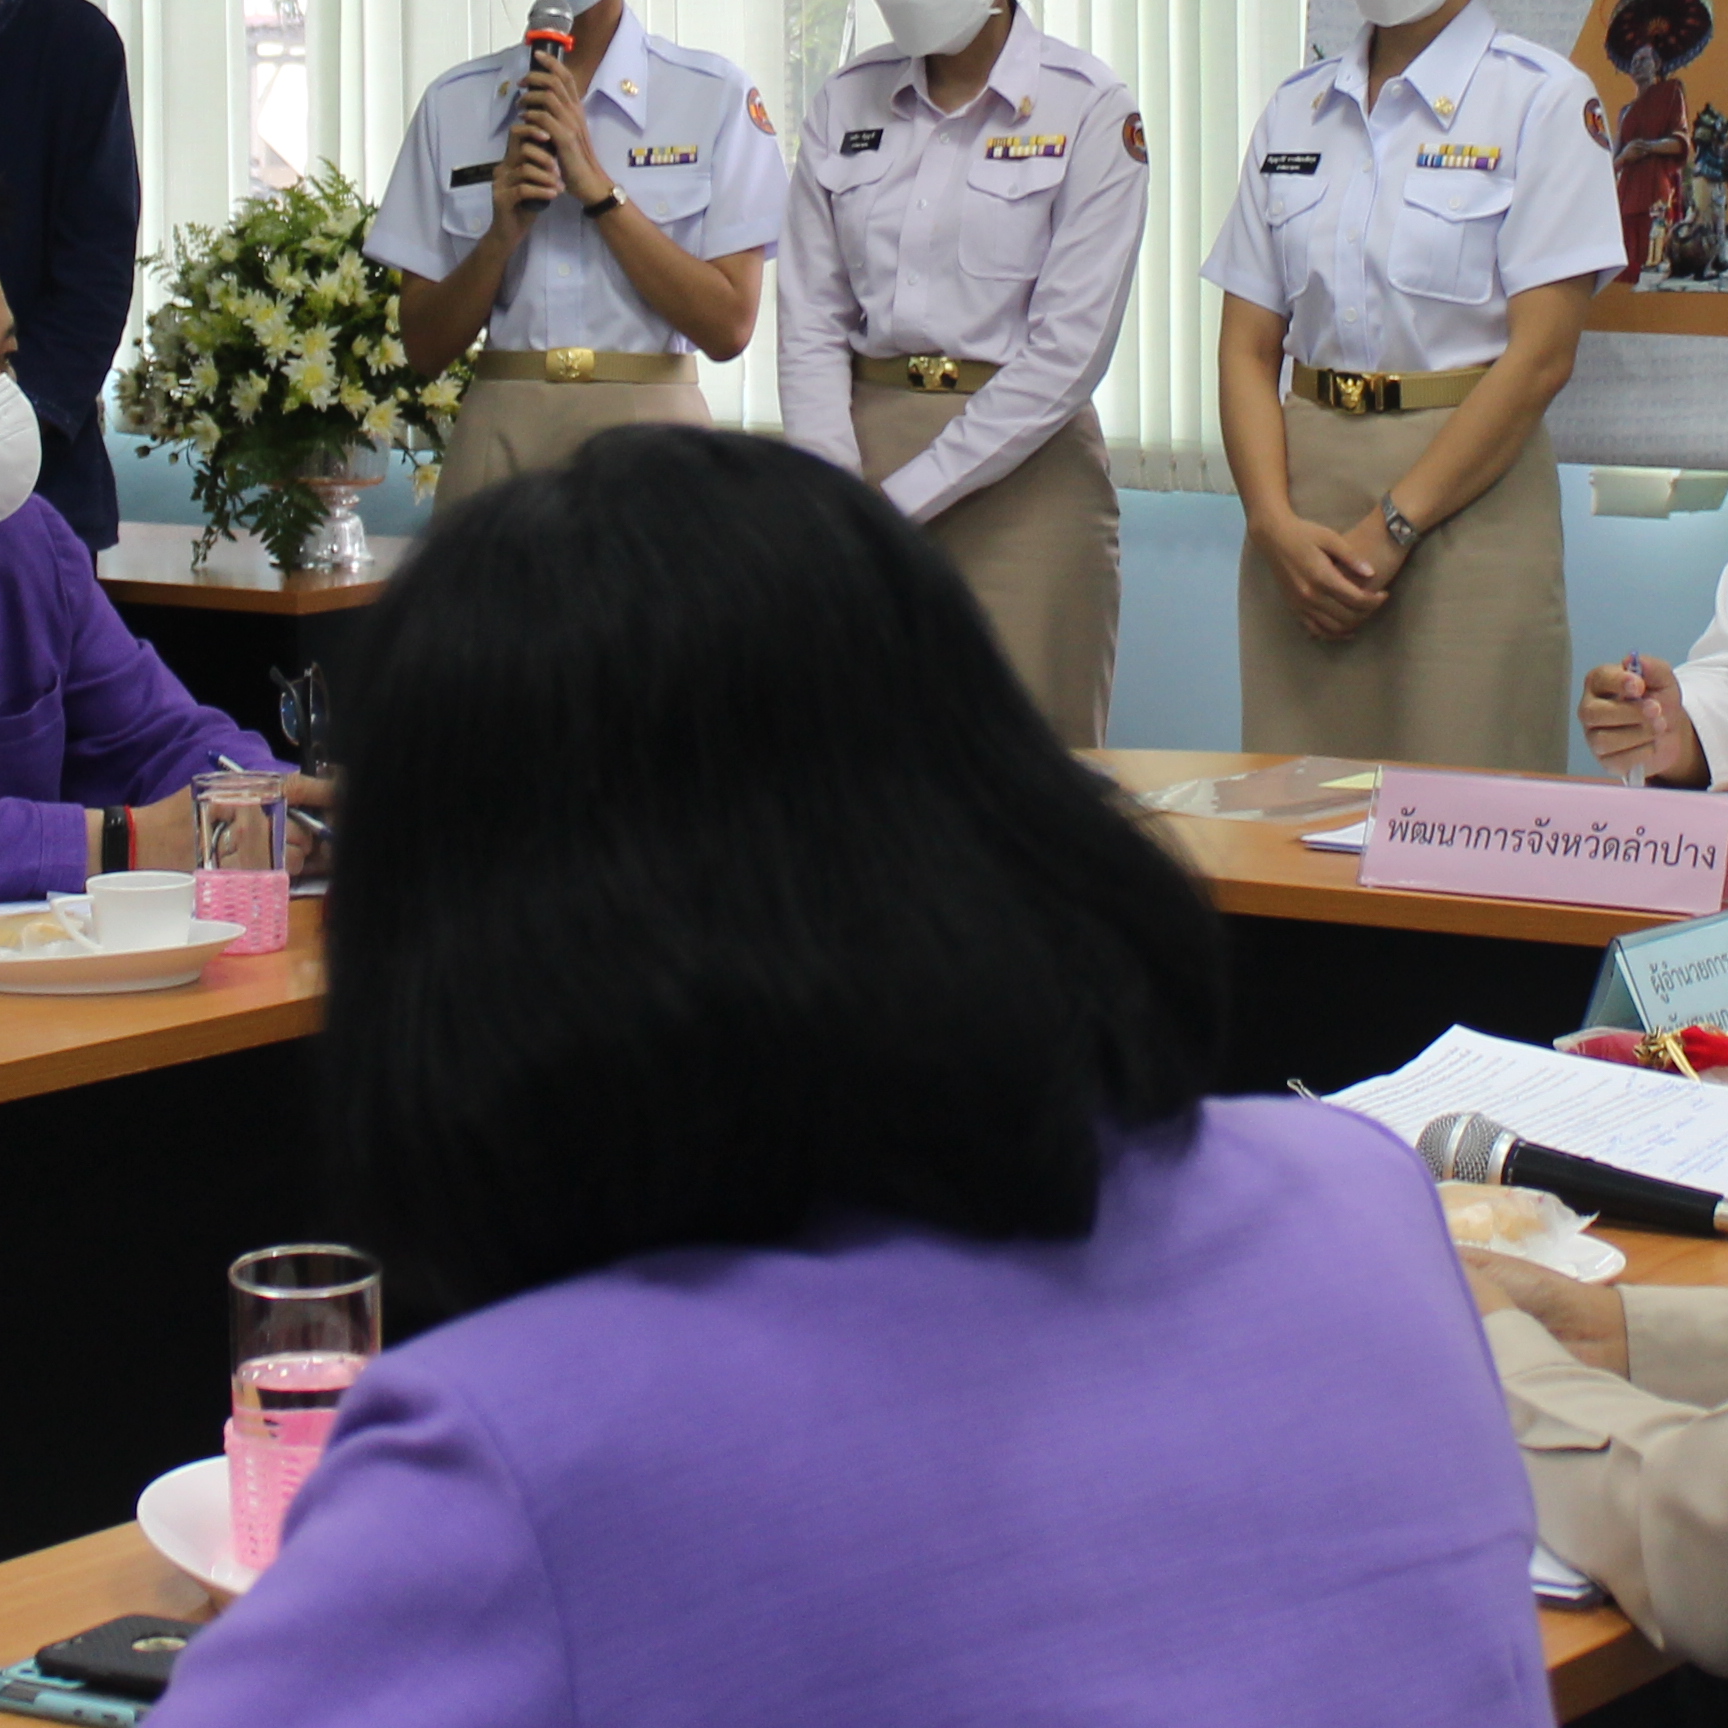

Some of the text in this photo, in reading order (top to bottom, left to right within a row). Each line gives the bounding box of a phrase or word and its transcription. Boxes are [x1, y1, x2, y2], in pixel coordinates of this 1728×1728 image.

[1388, 807, 1717, 870] พัฒนาการจังหวัดลำปาง
